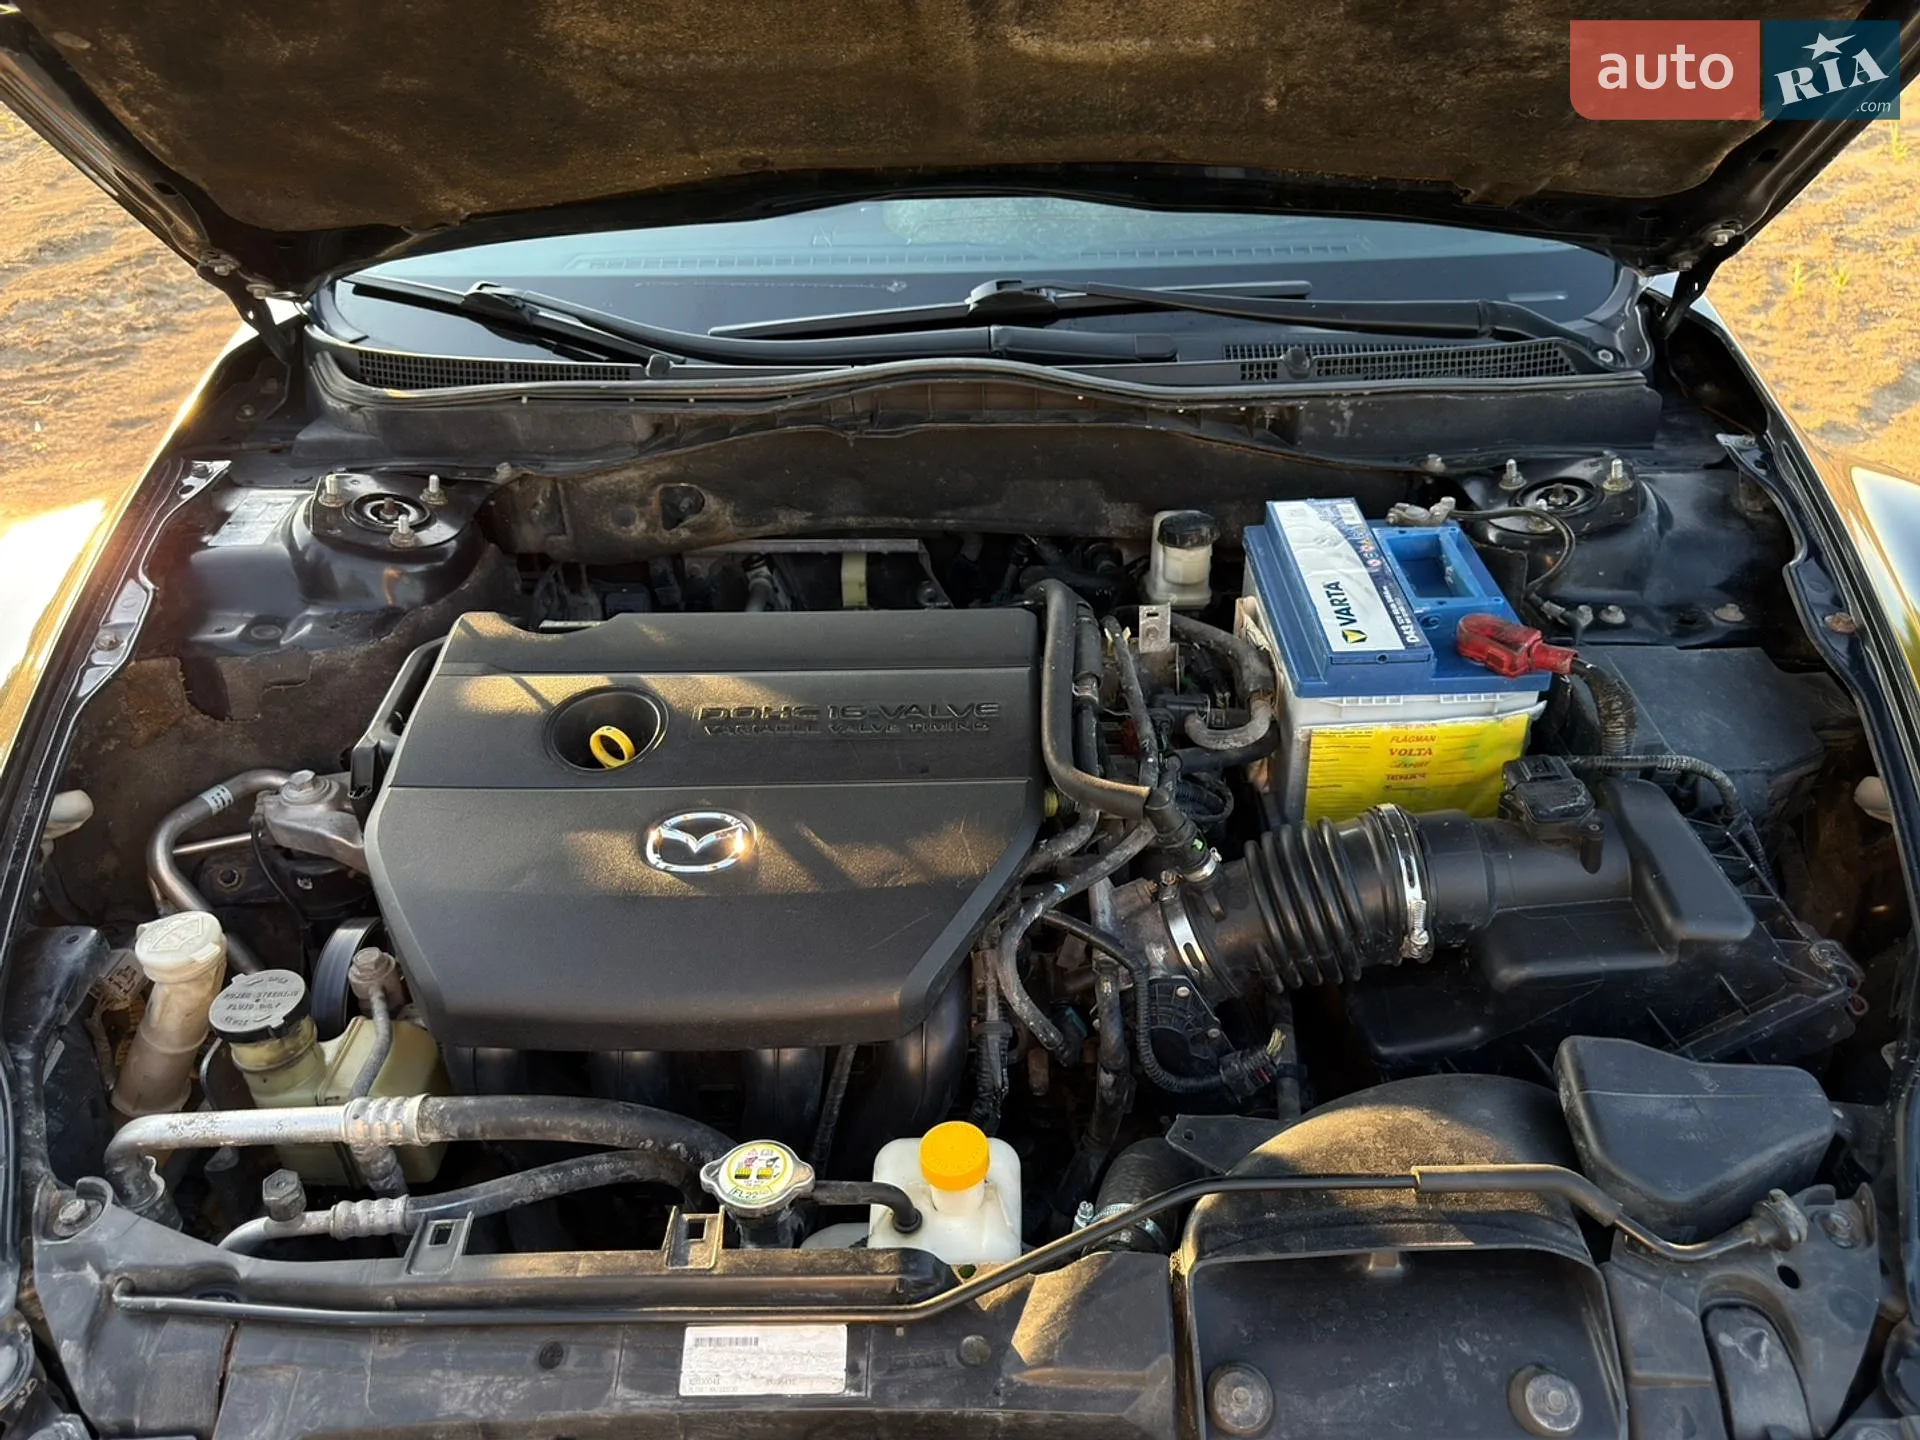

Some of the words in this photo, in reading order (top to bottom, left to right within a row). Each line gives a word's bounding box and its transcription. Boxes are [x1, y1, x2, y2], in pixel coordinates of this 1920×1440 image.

[1322, 580, 1358, 628] VARTA
[697, 705, 820, 721] DOHC
[828, 702, 1000, 720] 16-VALVE
[1389, 747, 1433, 757] VOLTA
